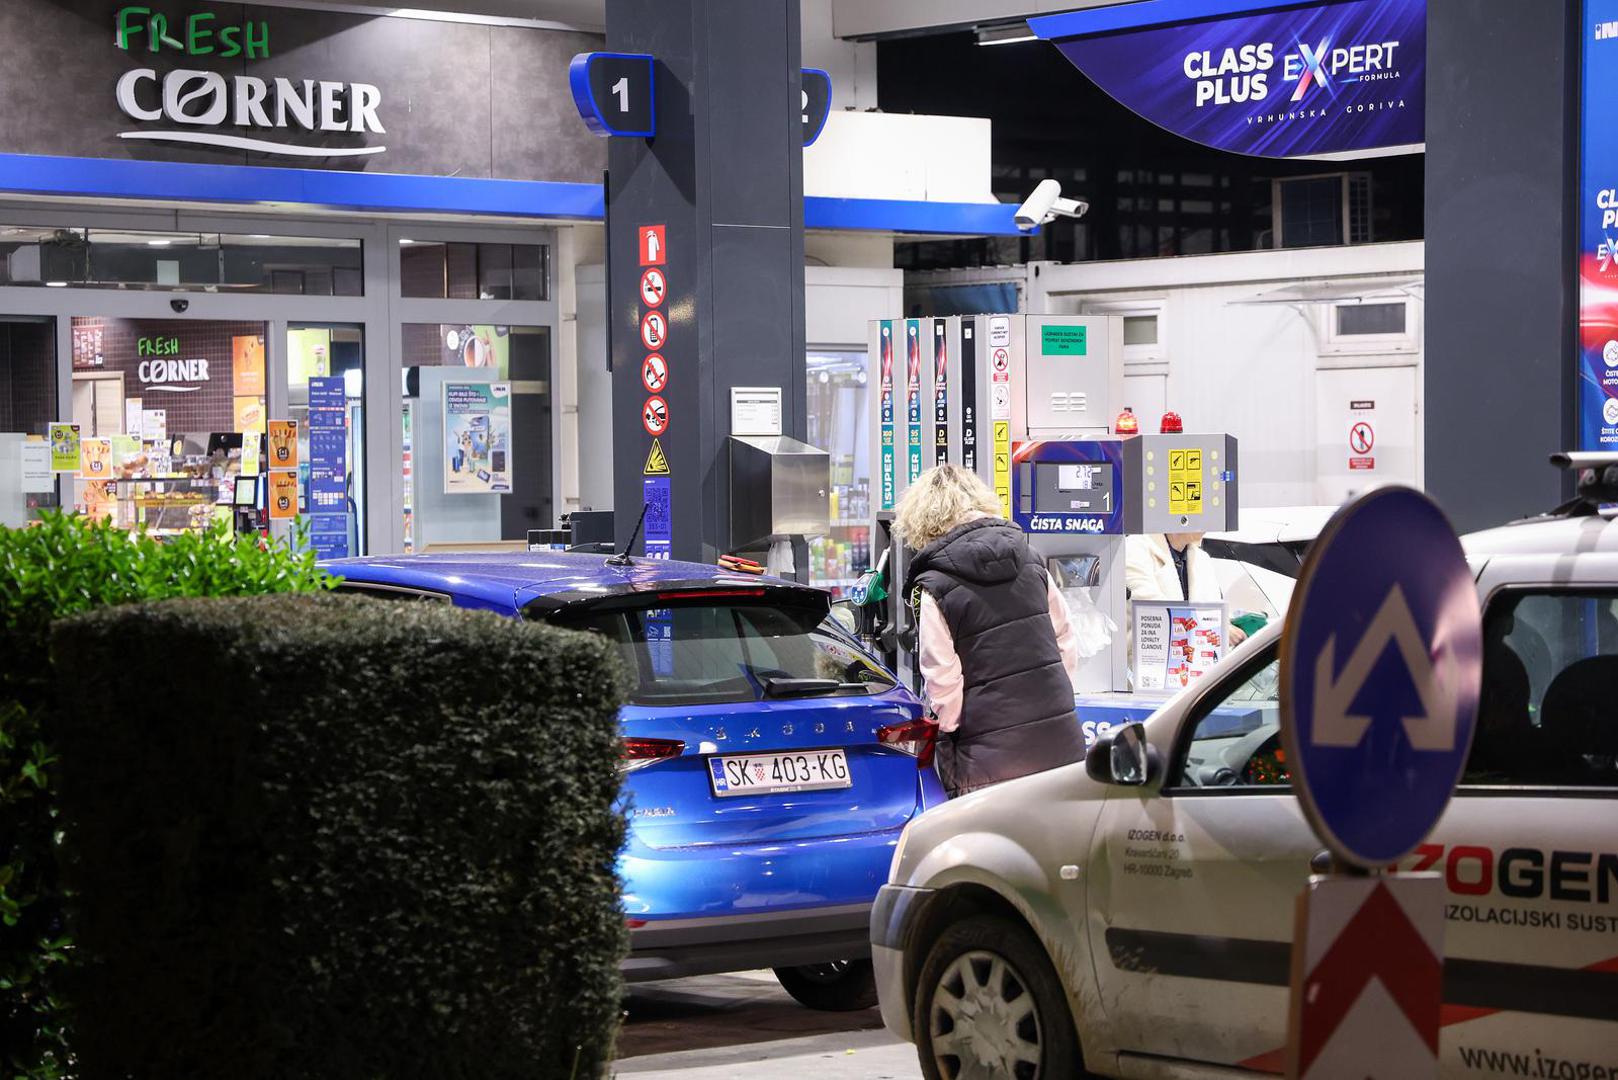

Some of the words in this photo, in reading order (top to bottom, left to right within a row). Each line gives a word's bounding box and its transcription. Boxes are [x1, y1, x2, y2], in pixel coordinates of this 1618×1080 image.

[1183, 42, 1274, 79] CLASS
[1283, 37, 1400, 102] EXPERT
[1195, 73, 1268, 107] PLUS
[1359, 71, 1401, 83] FORMULA
[116, 68, 386, 134] CORNER
[612, 77, 629, 112] 1
[1247, 109, 1327, 125] VRHUNSKA
[1346, 99, 1405, 114] GORIVA
[138, 359, 210, 383] CORNER
[1102, 492, 1110, 512] 1
[1030, 515, 1063, 530] ČISTA
[1064, 518, 1105, 531] SNAGA
[715, 778, 727, 786] HR
[726, 759, 754, 787] SK
[1127, 829, 1161, 841] IZOGEN
